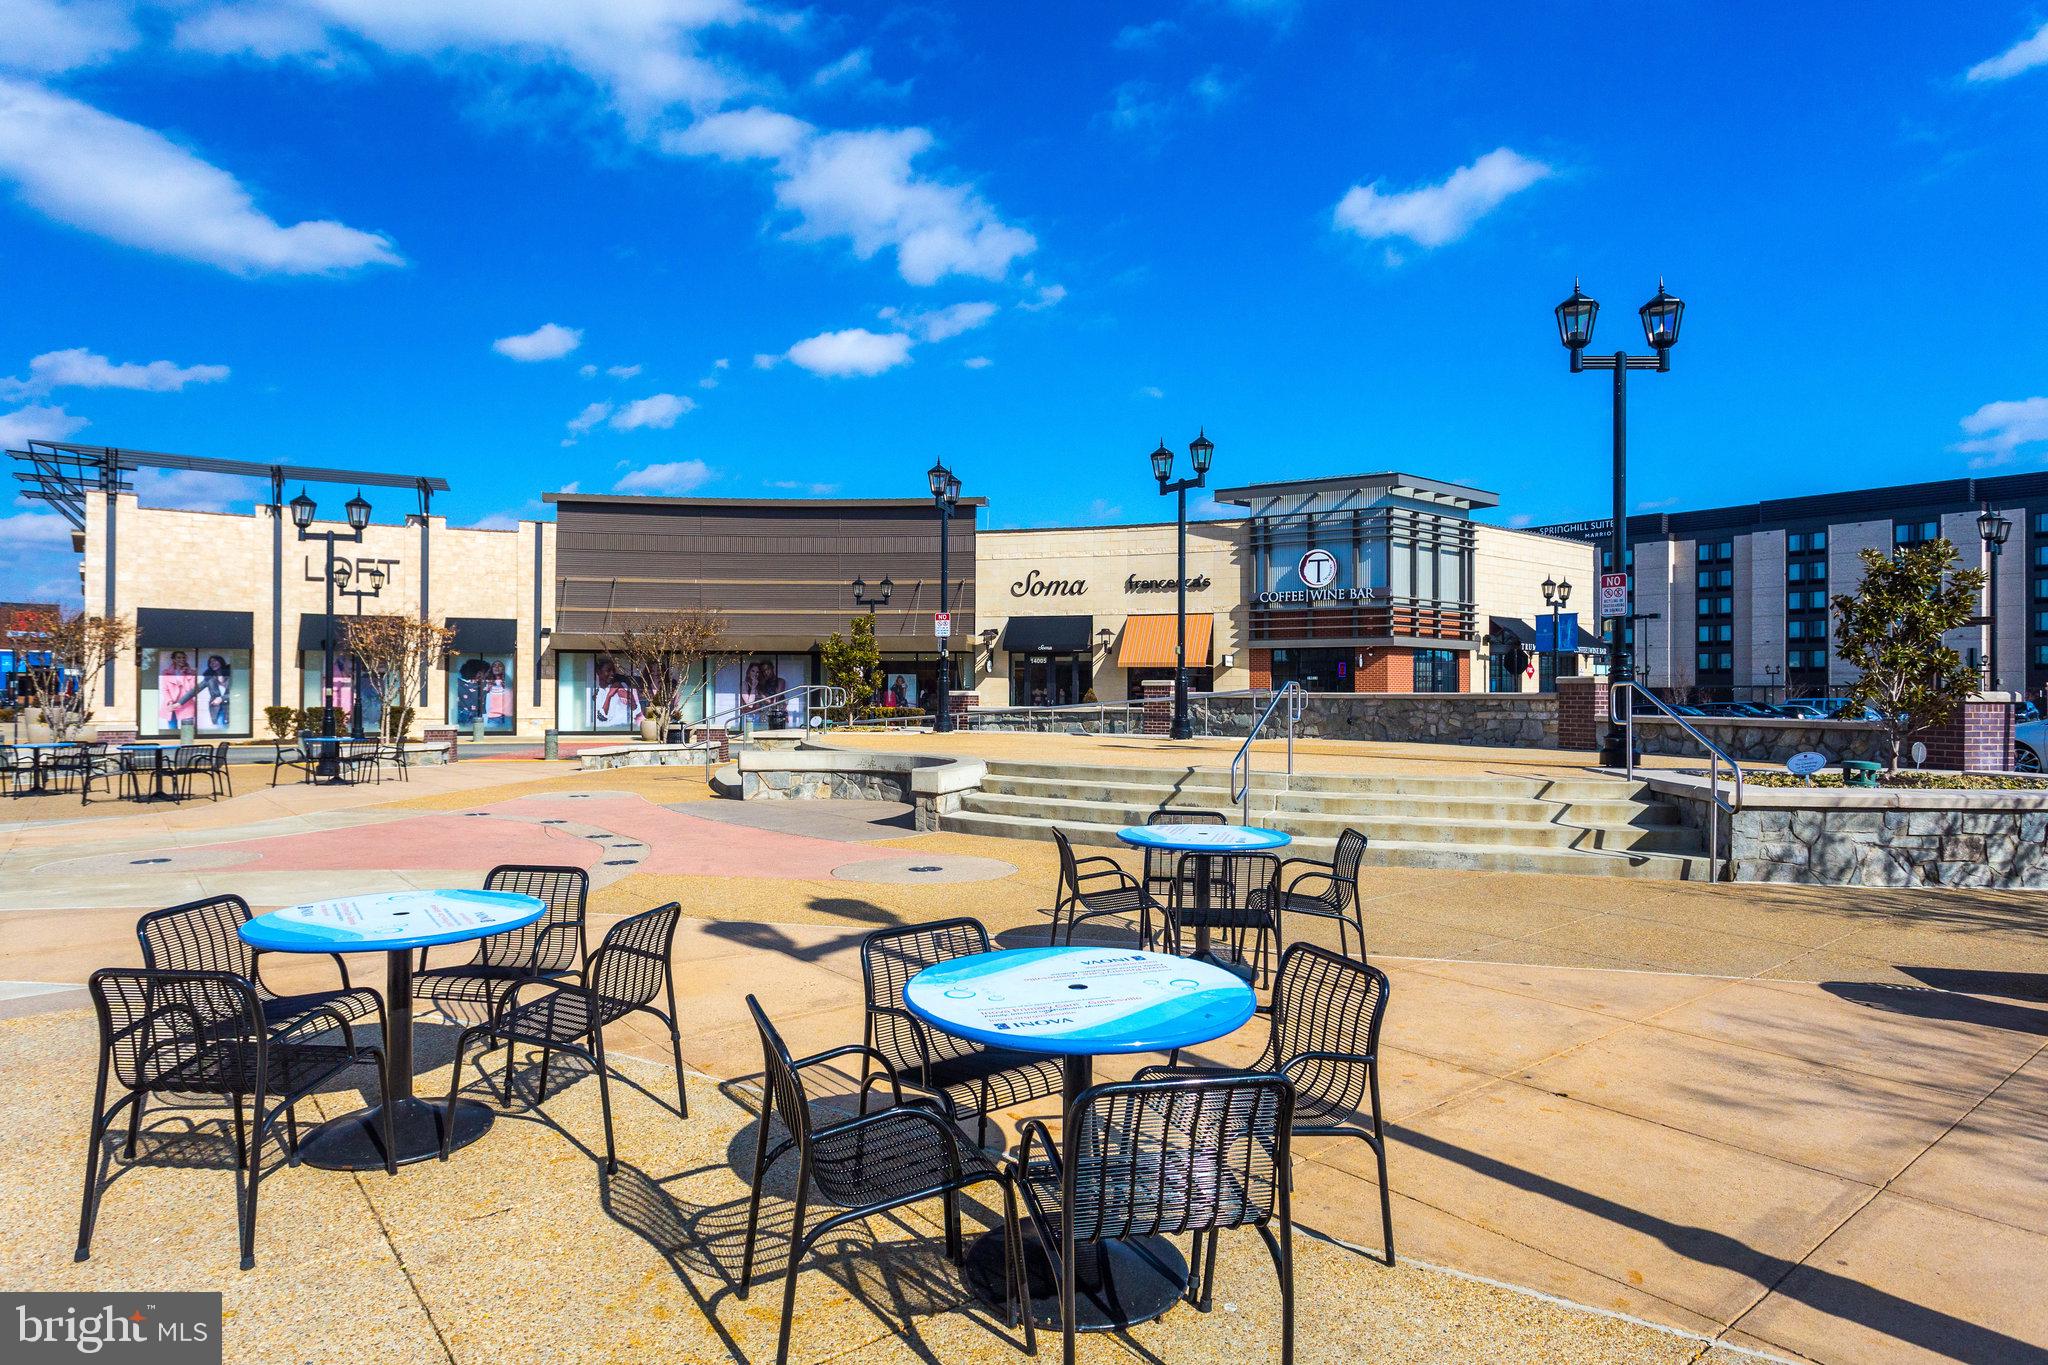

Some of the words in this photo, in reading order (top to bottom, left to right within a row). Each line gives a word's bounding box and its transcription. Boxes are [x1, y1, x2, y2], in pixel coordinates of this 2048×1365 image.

[1540, 523, 1589, 536] SPRINGHILL
[1590, 519, 1614, 531] SUITE
[1584, 530, 1614, 539] MARRIO
[1010, 569, 1089, 598] Soma
[1606, 576, 1621, 587] NO
[1350, 587, 1375, 599] BAR
[1030, 656, 1047, 664] 14005
[1012, 1017, 1075, 1028] INOVA
